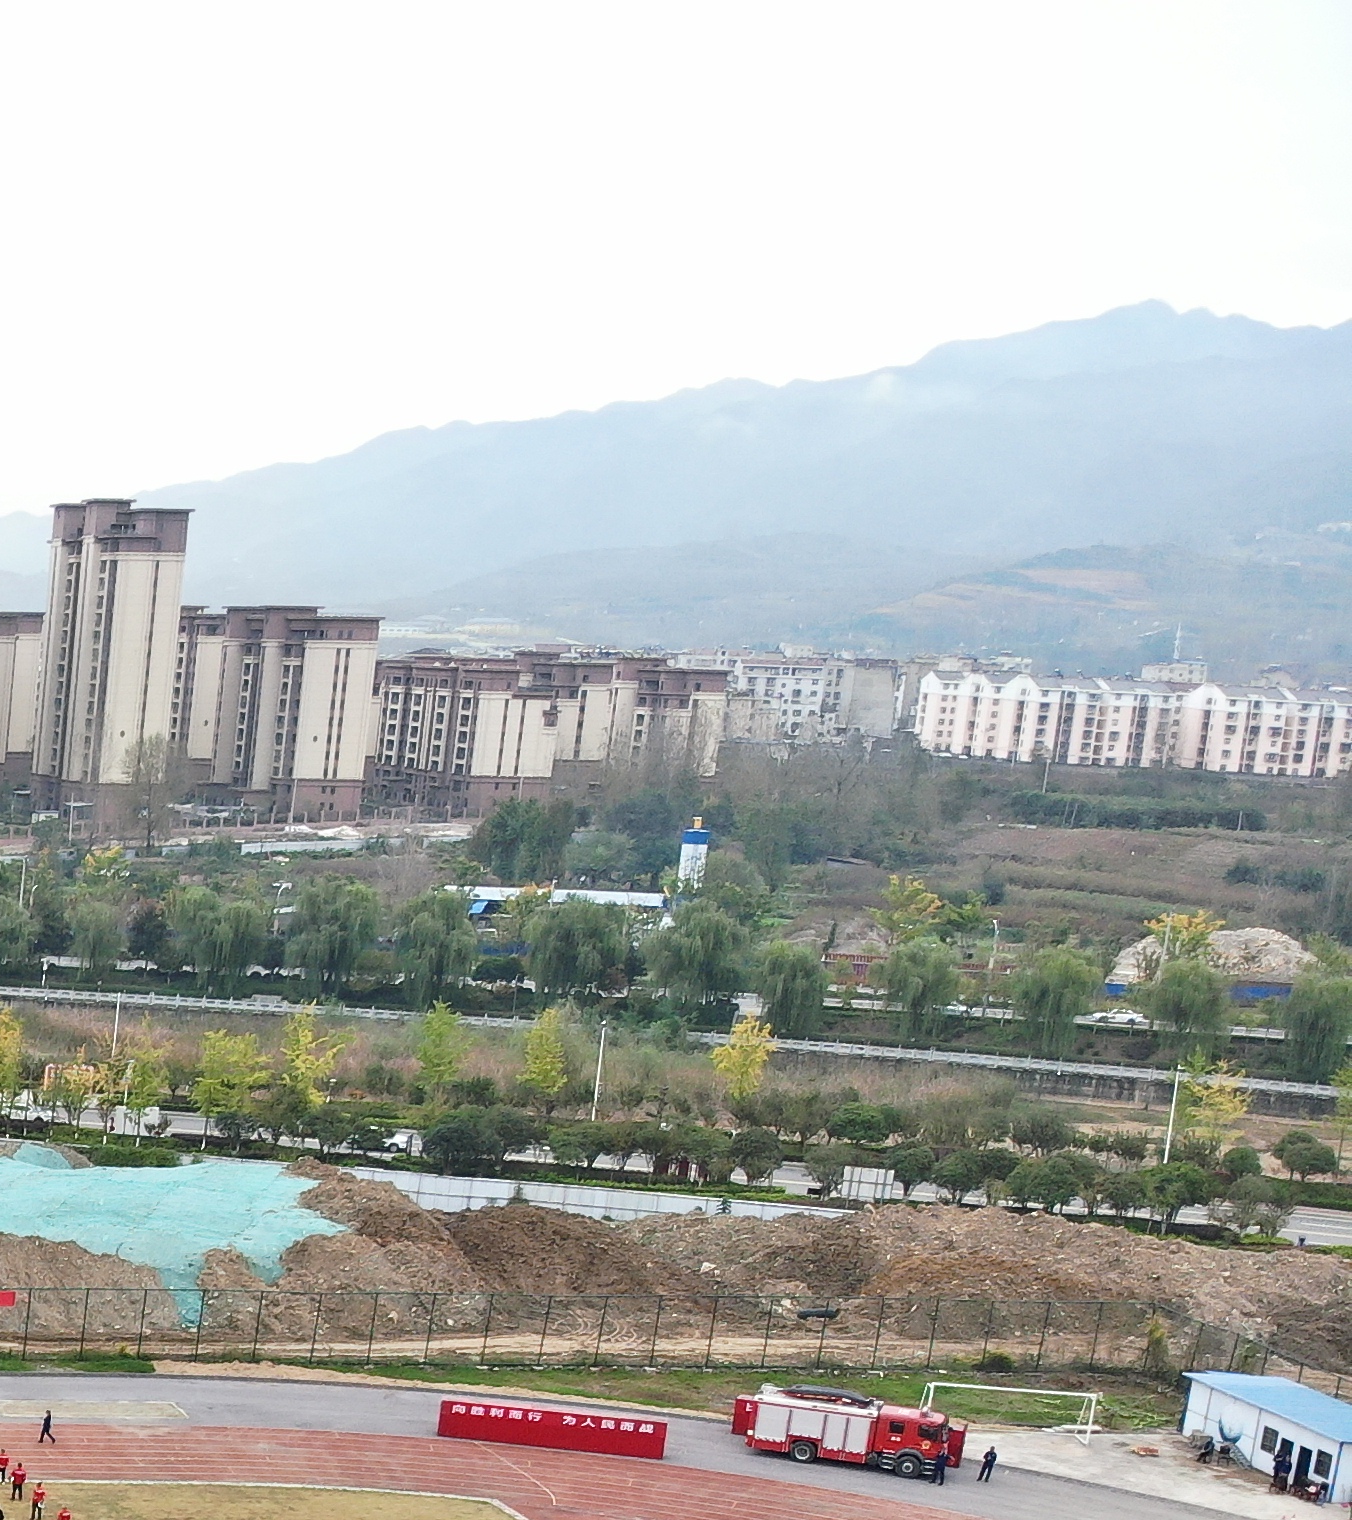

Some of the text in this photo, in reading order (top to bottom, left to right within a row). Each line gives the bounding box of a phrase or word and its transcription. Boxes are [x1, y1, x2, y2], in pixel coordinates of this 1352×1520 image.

[451, 1403, 654, 1434] 向胜利而行 为人民而战
